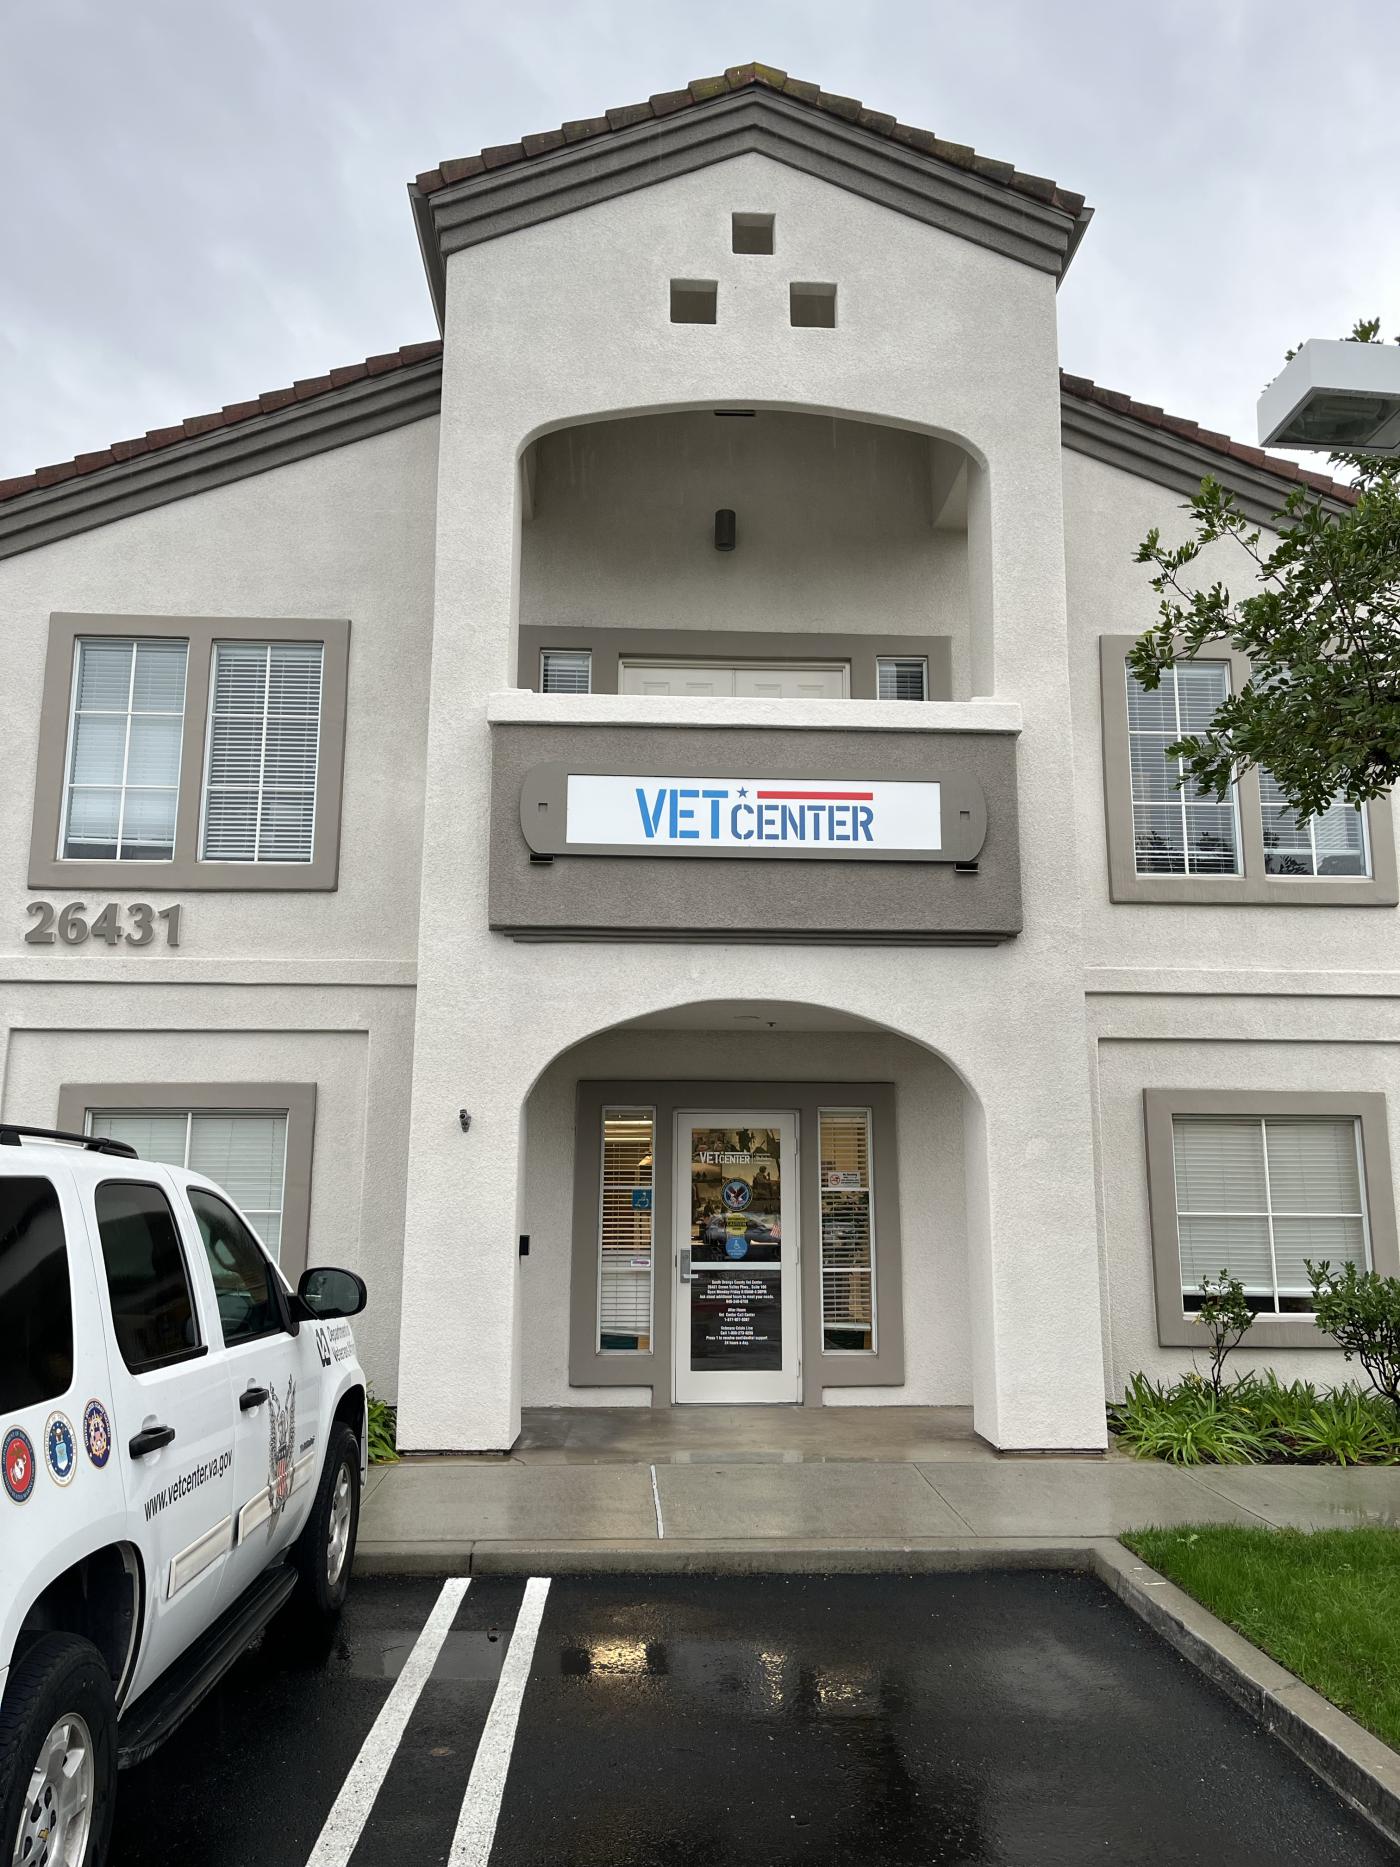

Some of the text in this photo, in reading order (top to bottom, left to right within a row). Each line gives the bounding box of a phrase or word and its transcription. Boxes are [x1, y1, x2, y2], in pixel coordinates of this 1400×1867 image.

[636, 788, 874, 842] VET CENTER
[25, 901, 182, 945] 26431
[699, 1151, 720, 1164] VET
[719, 1154, 751, 1164] CENTER
[144, 1449, 233, 1522] www.vetcenter.va.gov
